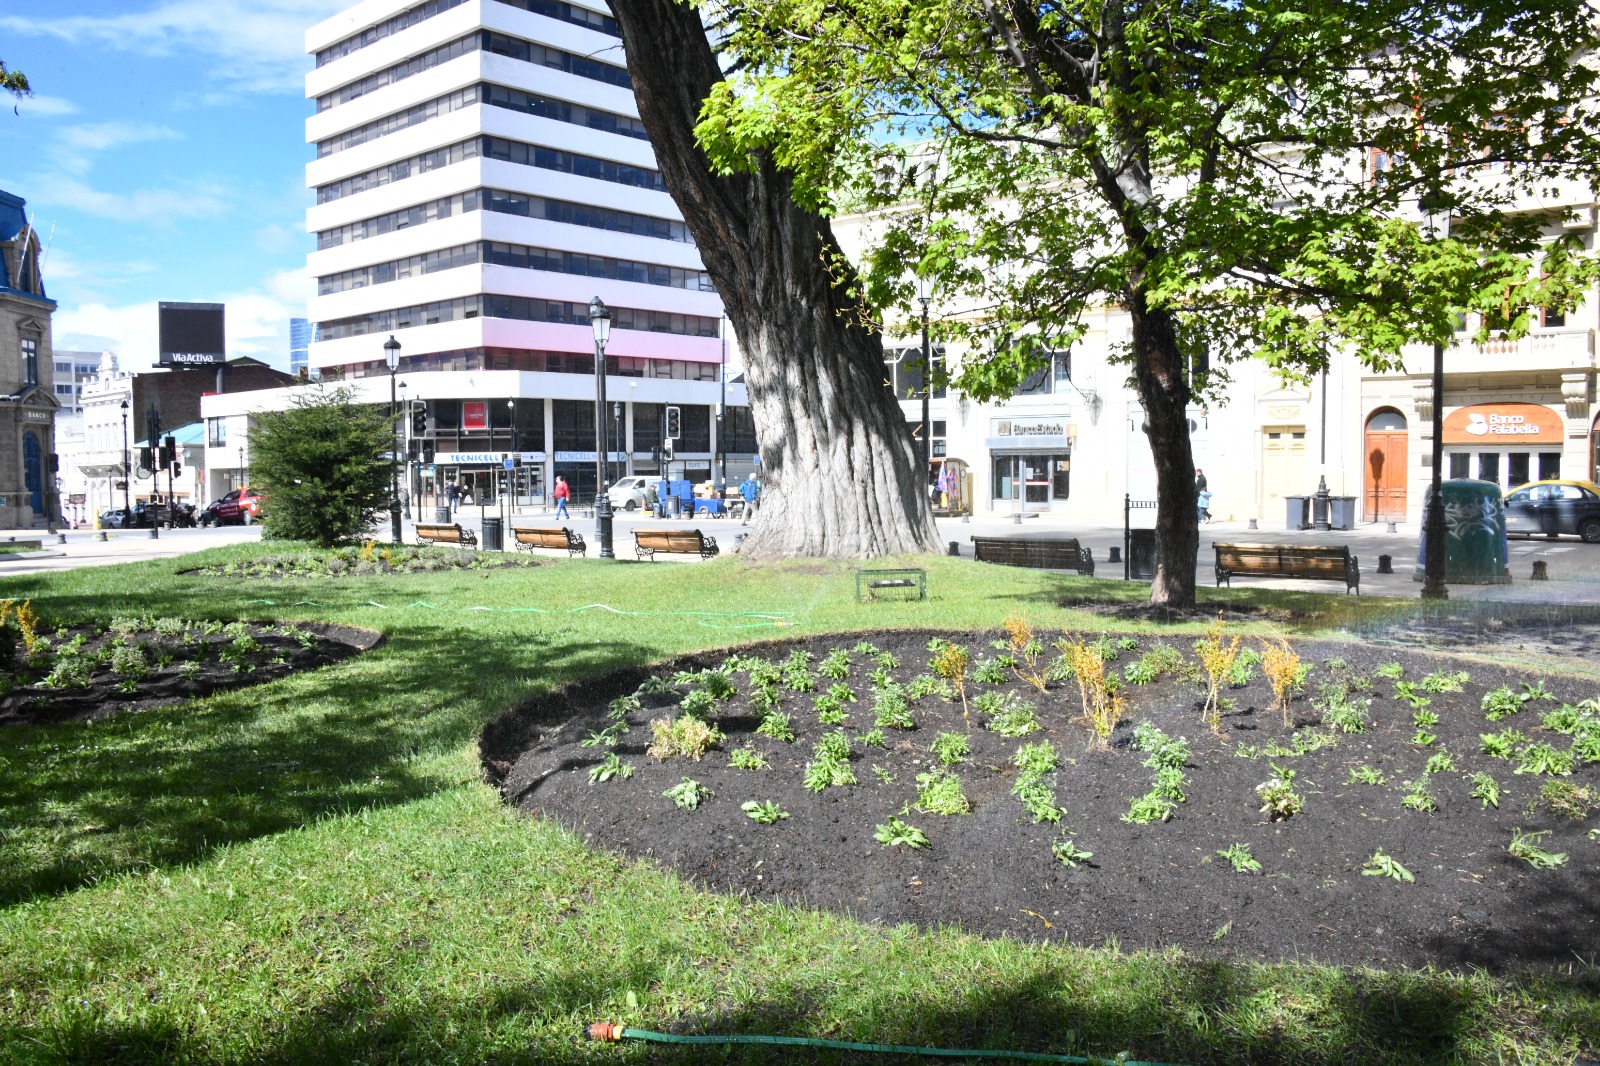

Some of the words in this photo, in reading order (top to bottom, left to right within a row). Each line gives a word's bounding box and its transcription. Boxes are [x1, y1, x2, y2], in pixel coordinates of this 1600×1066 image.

[1489, 414, 1524, 423] Banco
[1014, 424, 1063, 435] BancoEstado
[1489, 424, 1539, 434] Falabella
[450, 454, 499, 462] TECNICELL
[555, 452, 591, 460] TECNICELL
